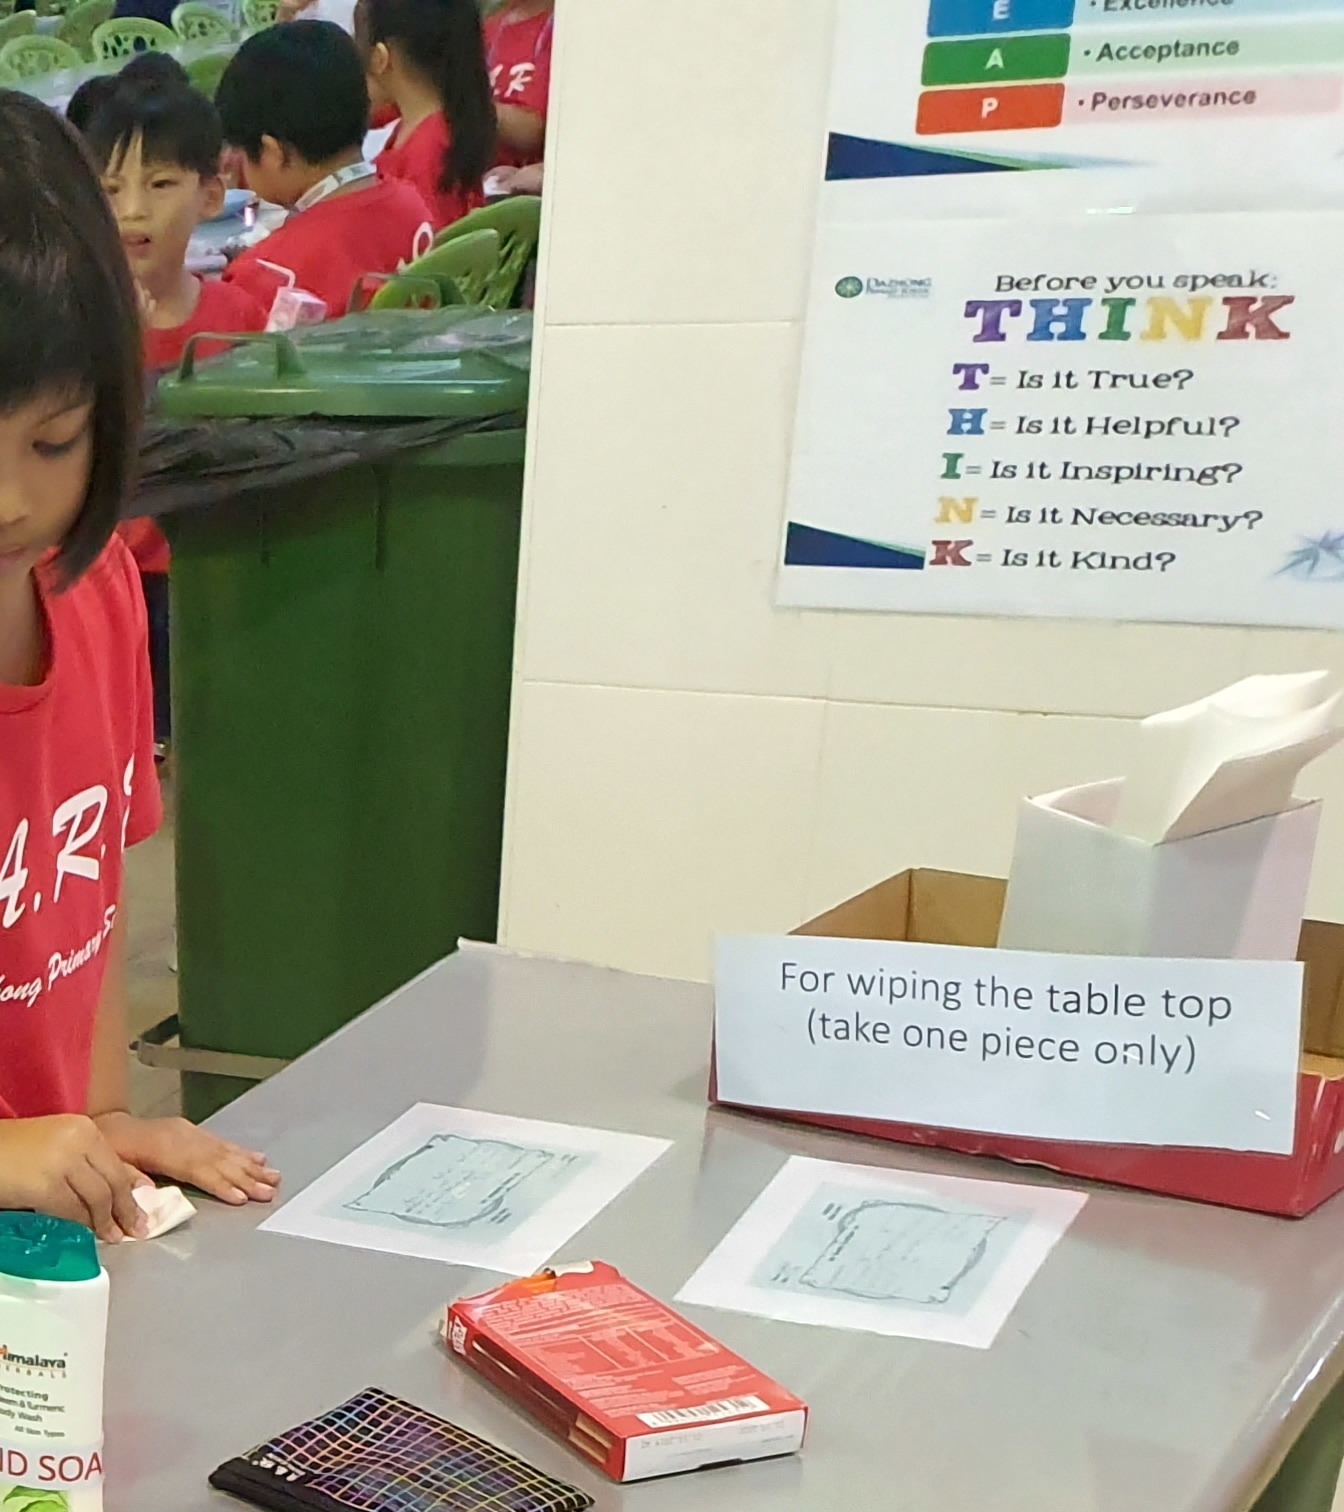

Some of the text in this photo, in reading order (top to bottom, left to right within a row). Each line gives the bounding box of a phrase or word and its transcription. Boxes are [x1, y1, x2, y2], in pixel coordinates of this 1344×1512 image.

[985, 38, 1240, 70] A Acceptance
[981, 88, 1258, 118] P Perseverance
[995, 269, 1279, 295] Before you speak:
[963, 296, 1296, 343] THINK
[1016, 369, 1043, 390] Is
[1051, 370, 1078, 390] it
[1087, 368, 1194, 391] True?
[1016, 416, 1043, 435] Is
[1051, 416, 1077, 435] it
[1086, 414, 1241, 438] Helpful?
[991, 460, 1018, 480] Is
[1026, 460, 1051, 480] it
[1061, 460, 1243, 486] Inspiring?
[1005, 506, 1031, 524] Is
[1038, 506, 1063, 524] it
[1071, 506, 1264, 532] Necessary?
[1002, 550, 1029, 568] Is
[1036, 550, 1061, 569] it
[1070, 550, 1177, 572] Kind?
[781, 961, 1233, 1027] For wiping the table top
[807, 1007, 1197, 1075] (take one piece only)
[37, 1451, 103, 1483] SOA
